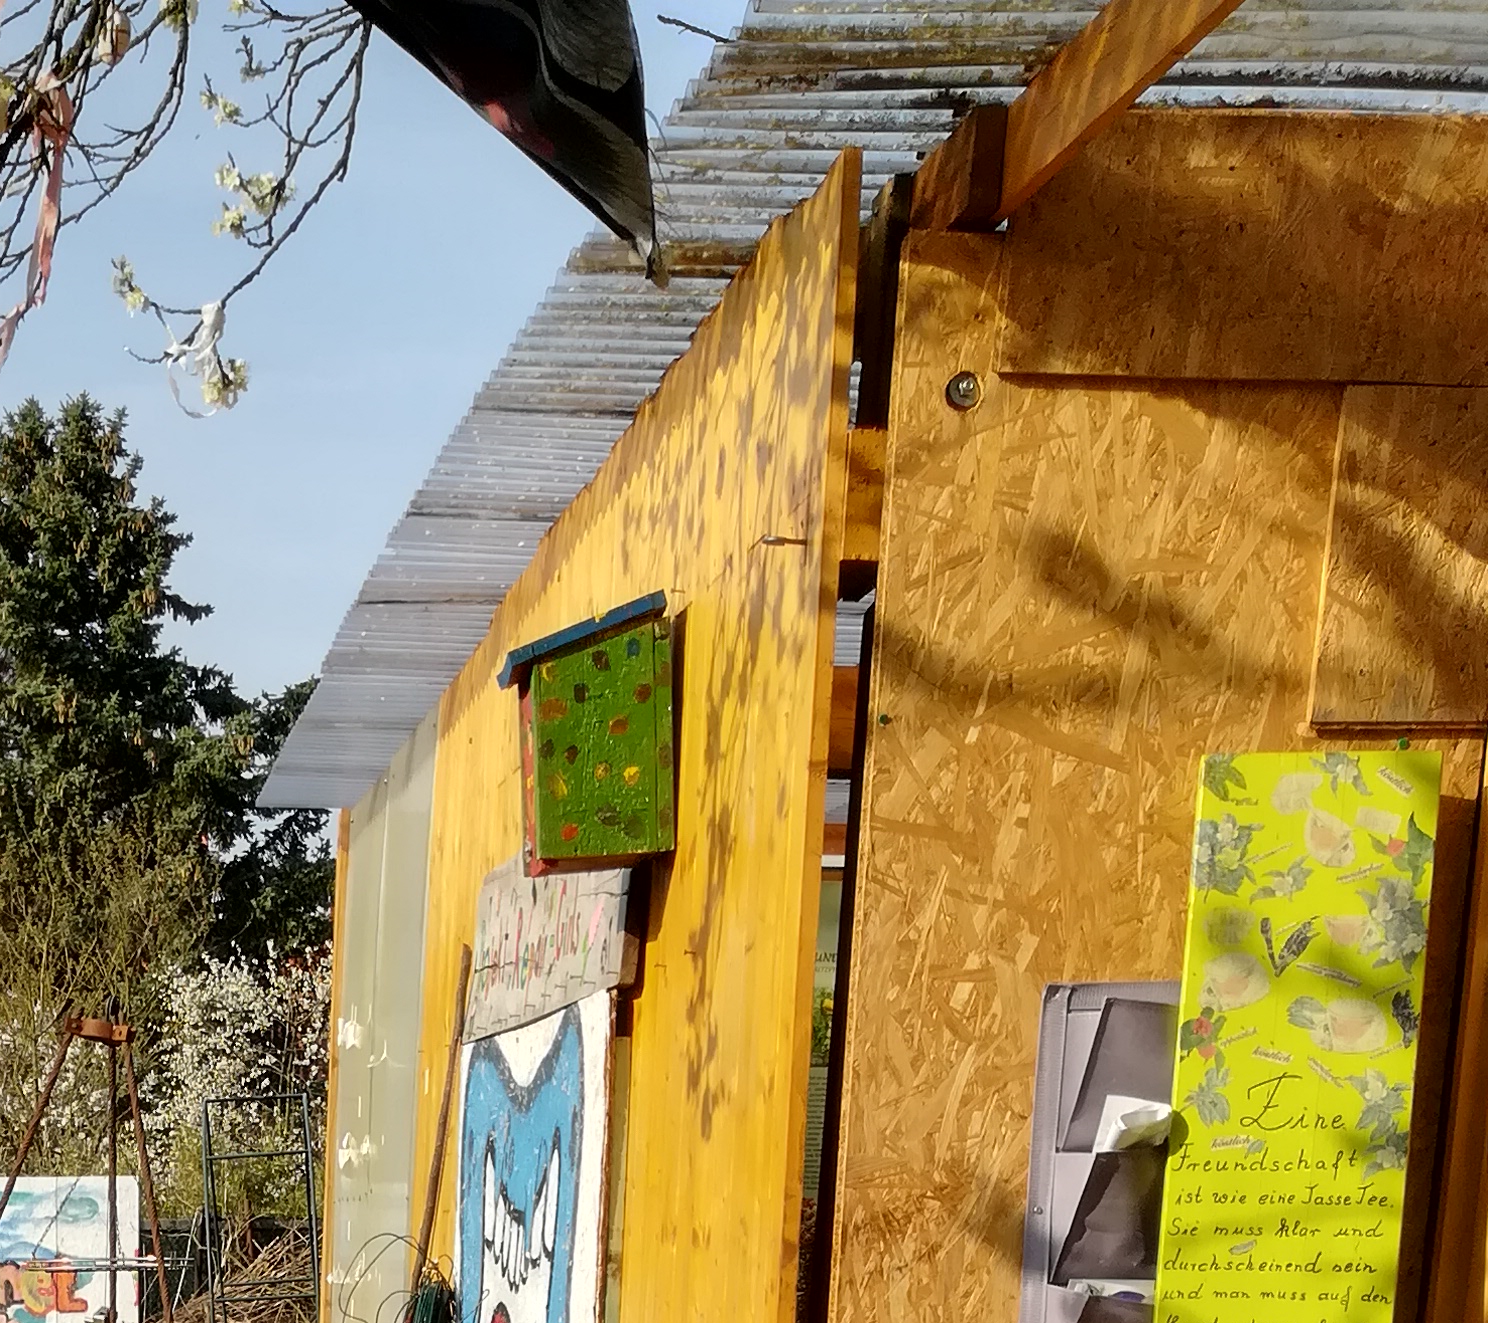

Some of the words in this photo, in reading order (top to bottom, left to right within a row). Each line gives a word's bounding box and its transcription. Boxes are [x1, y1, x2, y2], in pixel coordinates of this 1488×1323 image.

[1240, 1072, 1348, 1131] Eine
[1171, 1143, 1358, 1181] Freundschaft
[1175, 1186, 1203, 1206] ist
[1211, 1190, 1247, 1205] wie
[1258, 1190, 1296, 1205] eine
[1301, 1183, 1352, 1206] Tasse
[1355, 1182, 1395, 1208] Tee.
[1167, 1217, 1200, 1237] Sie
[1213, 1225, 1264, 1237] muss
[1274, 1218, 1321, 1239] klar
[1333, 1219, 1384, 1238] und
[1163, 1248, 1322, 1274] durchscheinend
[1331, 1258, 1377, 1274] sein
[1161, 1283, 1204, 1301] und
[1212, 1289, 1252, 1300] man
[1260, 1290, 1307, 1301] muss
[1317, 1286, 1352, 1312] auf
[1360, 1285, 1392, 1304] den
